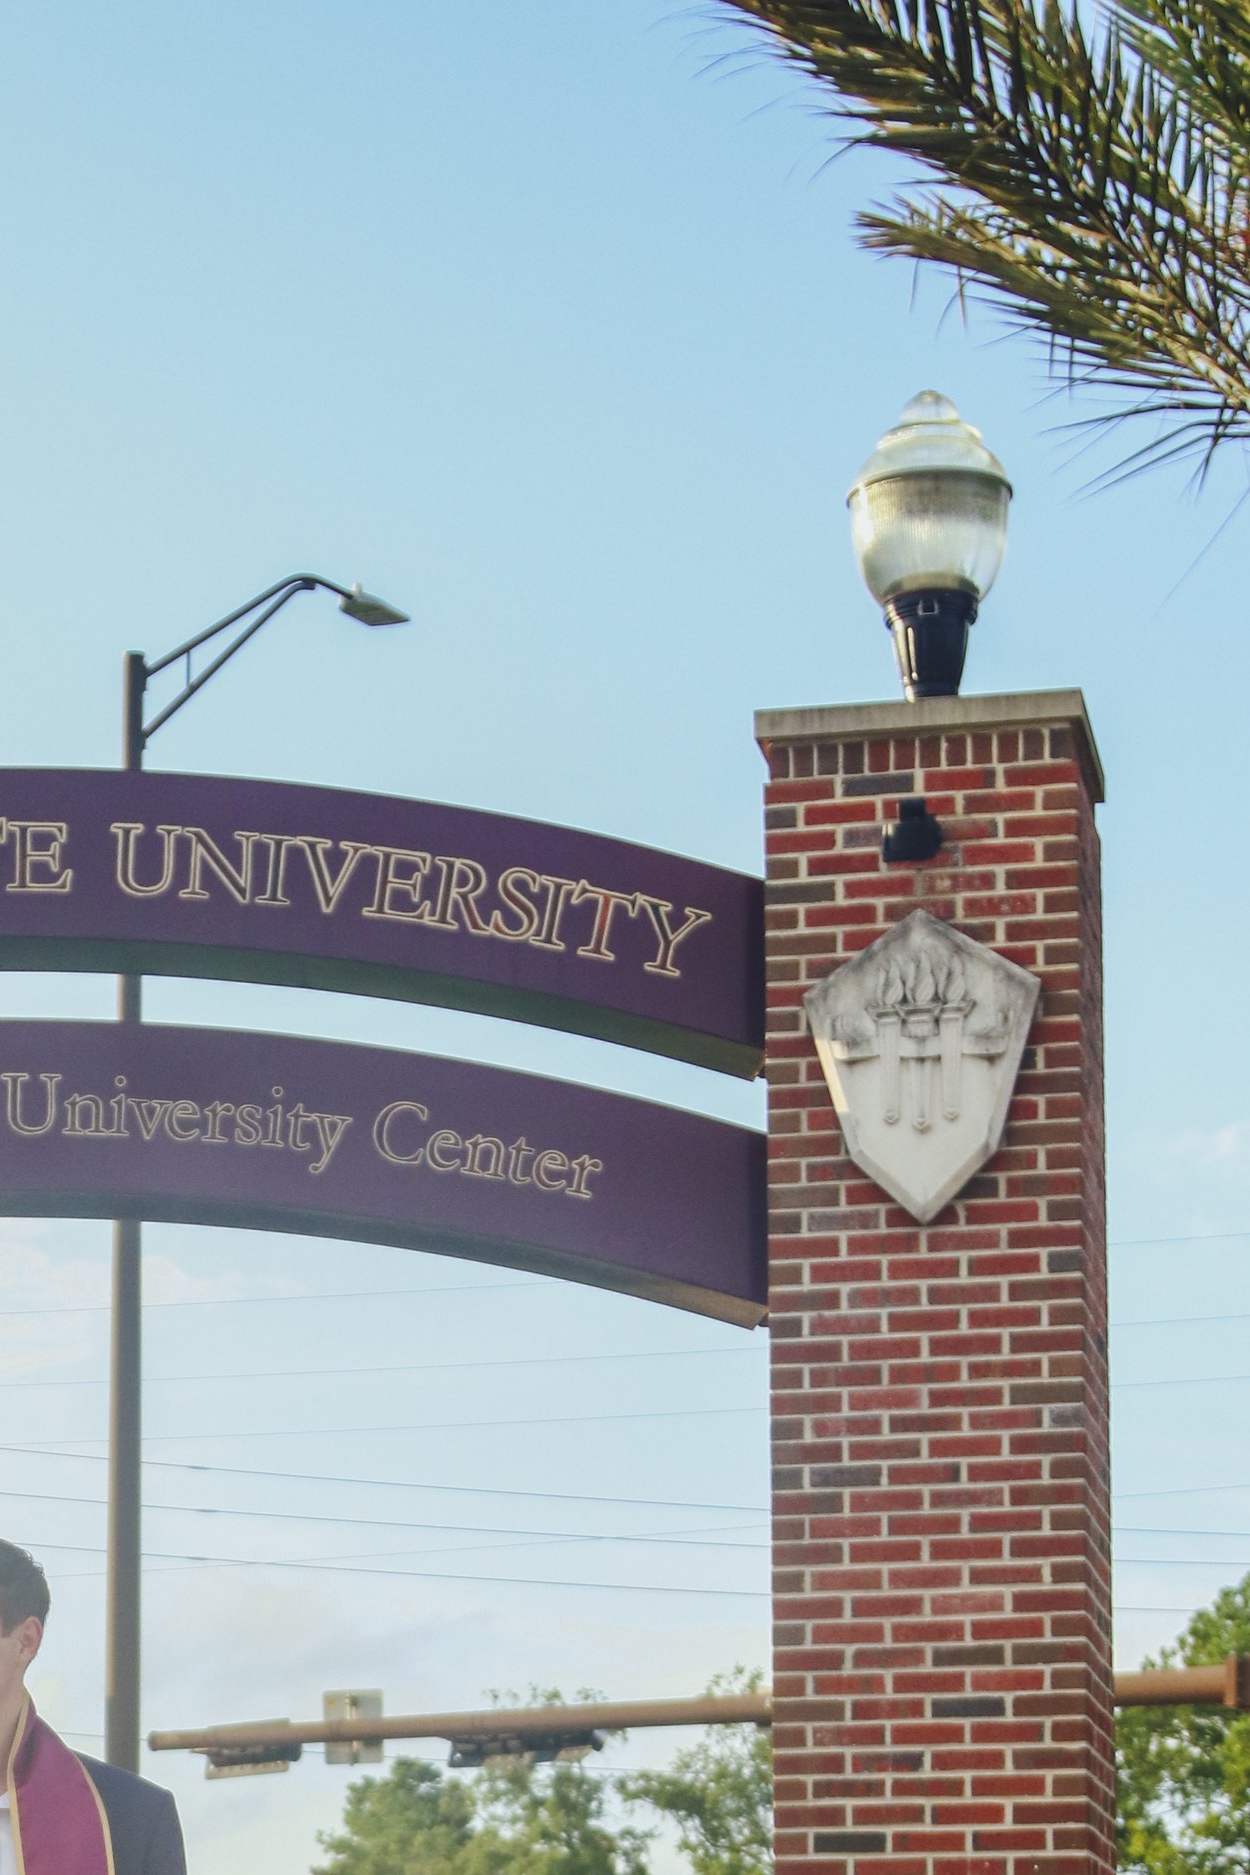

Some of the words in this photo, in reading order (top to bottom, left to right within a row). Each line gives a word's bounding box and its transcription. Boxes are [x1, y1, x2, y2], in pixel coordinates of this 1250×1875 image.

[110, 822, 712, 978] UNIVERSITY
[1, 1072, 352, 1174] University
[372, 1101, 605, 1200] Center
